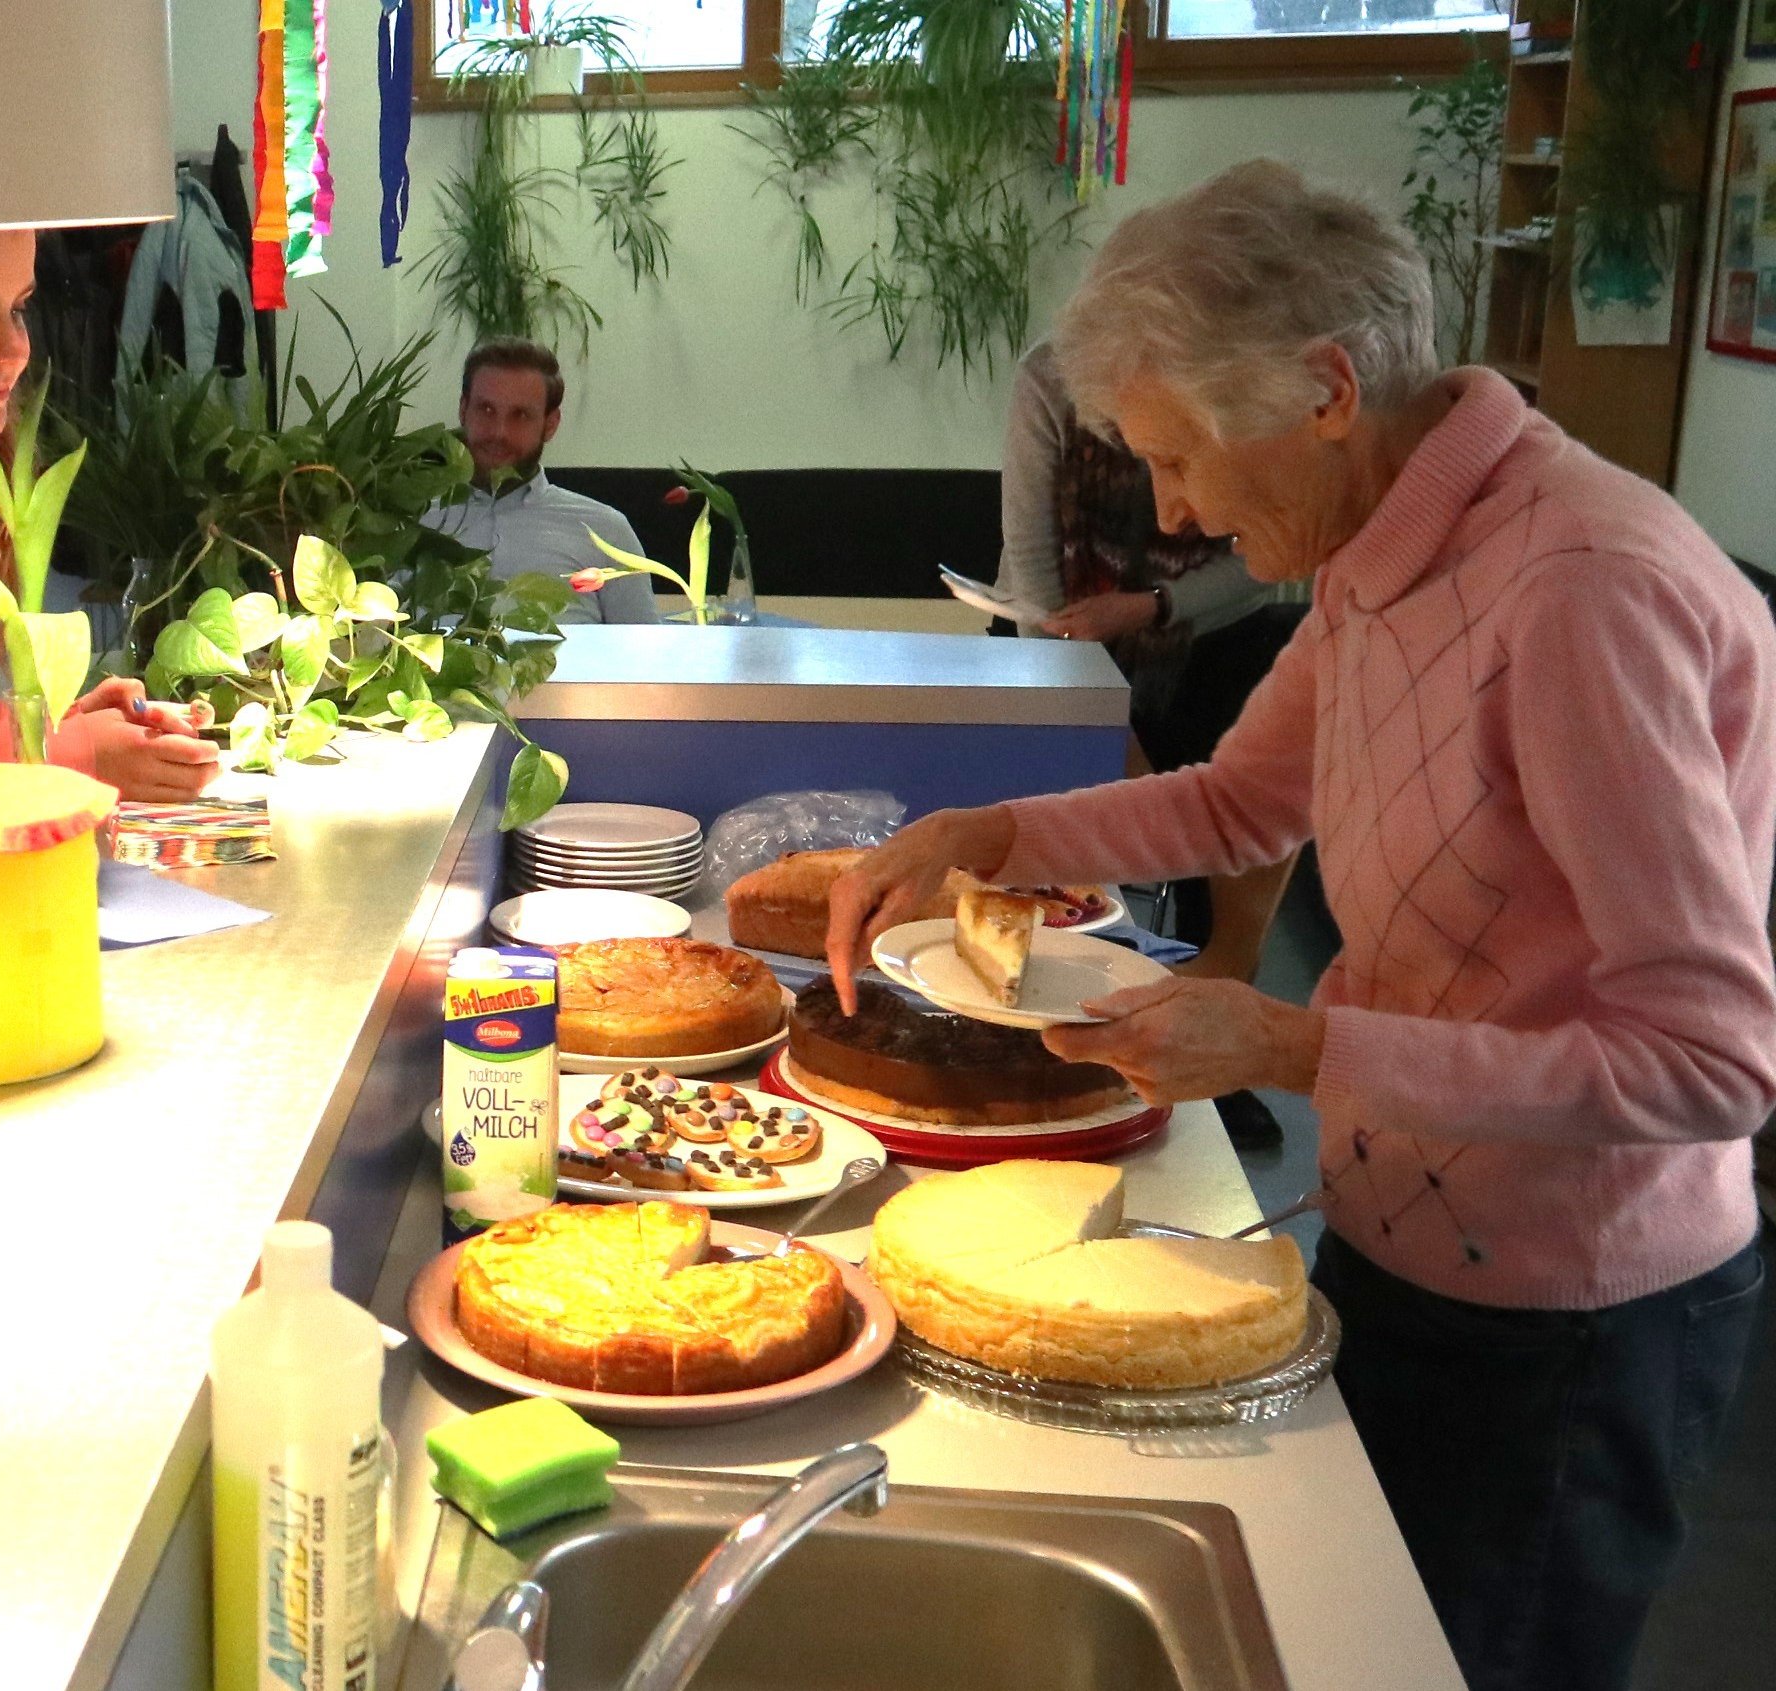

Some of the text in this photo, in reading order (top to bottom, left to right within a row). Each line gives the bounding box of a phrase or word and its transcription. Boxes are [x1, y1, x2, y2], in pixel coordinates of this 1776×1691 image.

[477, 1027, 520, 1038] Milbona
[468, 1068, 523, 1083] haltbare
[462, 1087, 526, 1111] VOLL-
[473, 1115, 538, 1138] MILCH
[312, 1496, 325, 1543] CLASS
[312, 1550, 325, 1618] COMPACT
